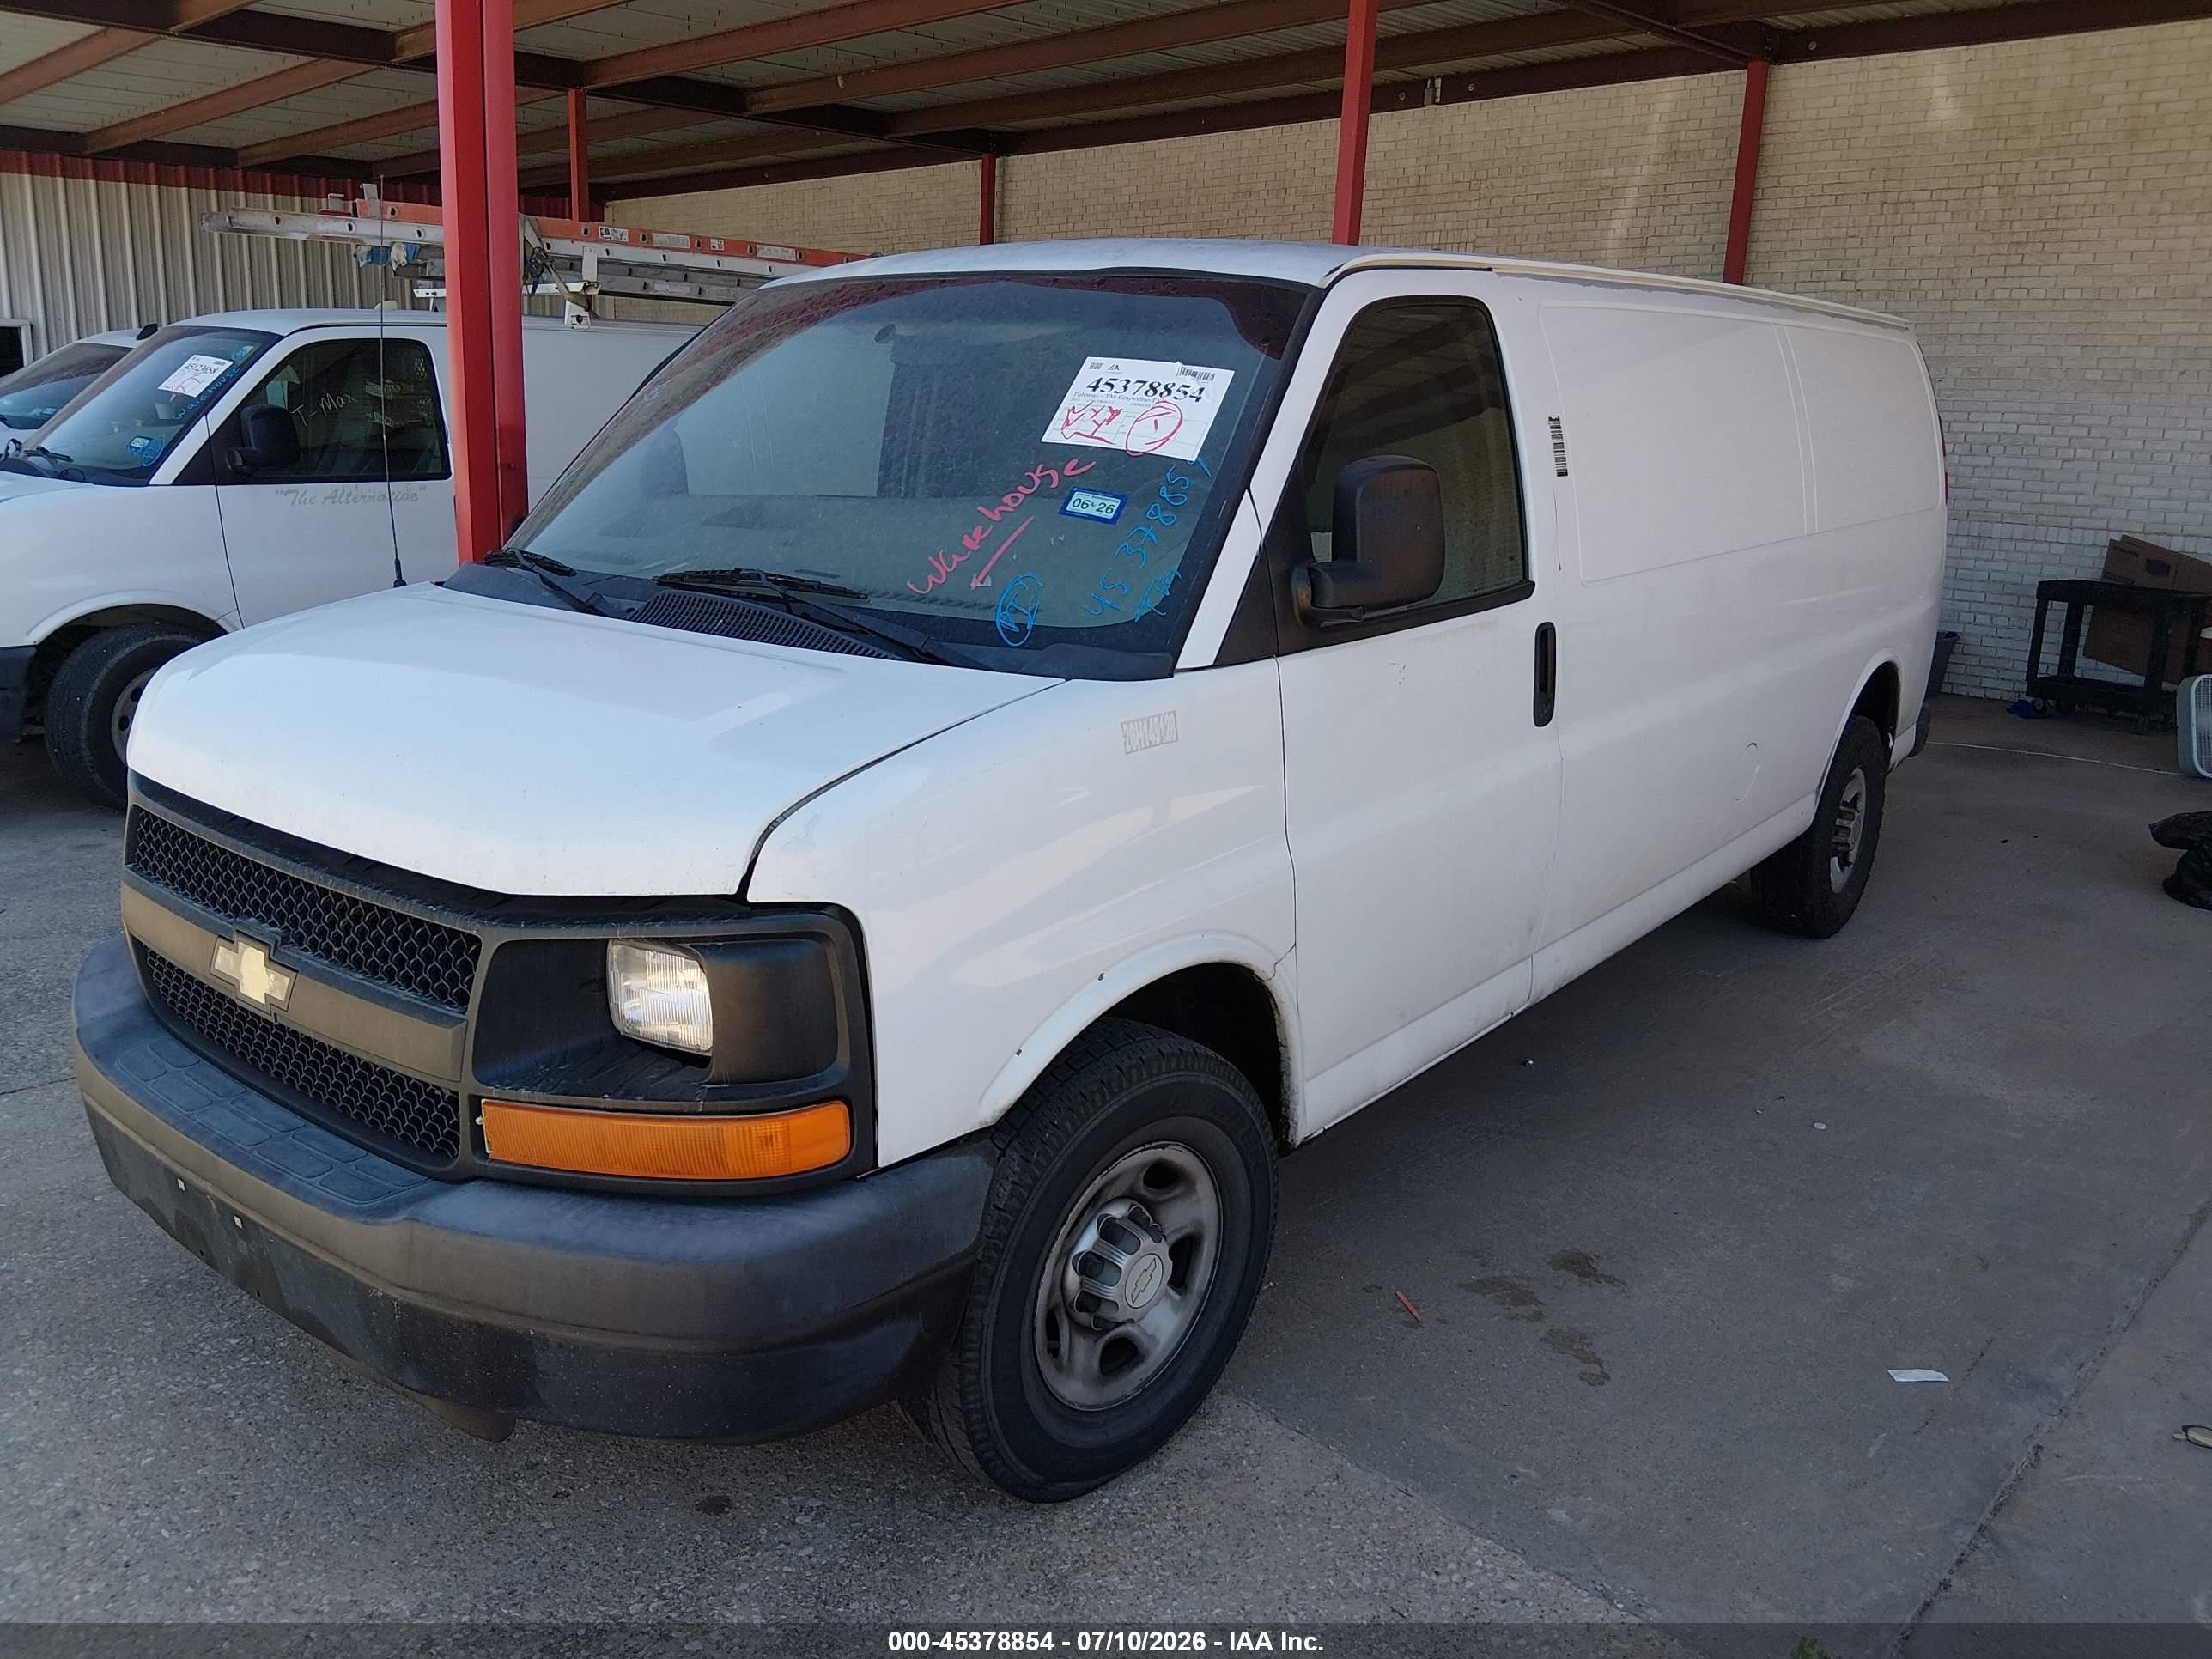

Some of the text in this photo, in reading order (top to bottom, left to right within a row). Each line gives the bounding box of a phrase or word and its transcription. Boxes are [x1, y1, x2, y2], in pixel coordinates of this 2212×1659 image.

[1086, 377, 1206, 403] 45378854
[1072, 498, 1115, 514] 06 26
